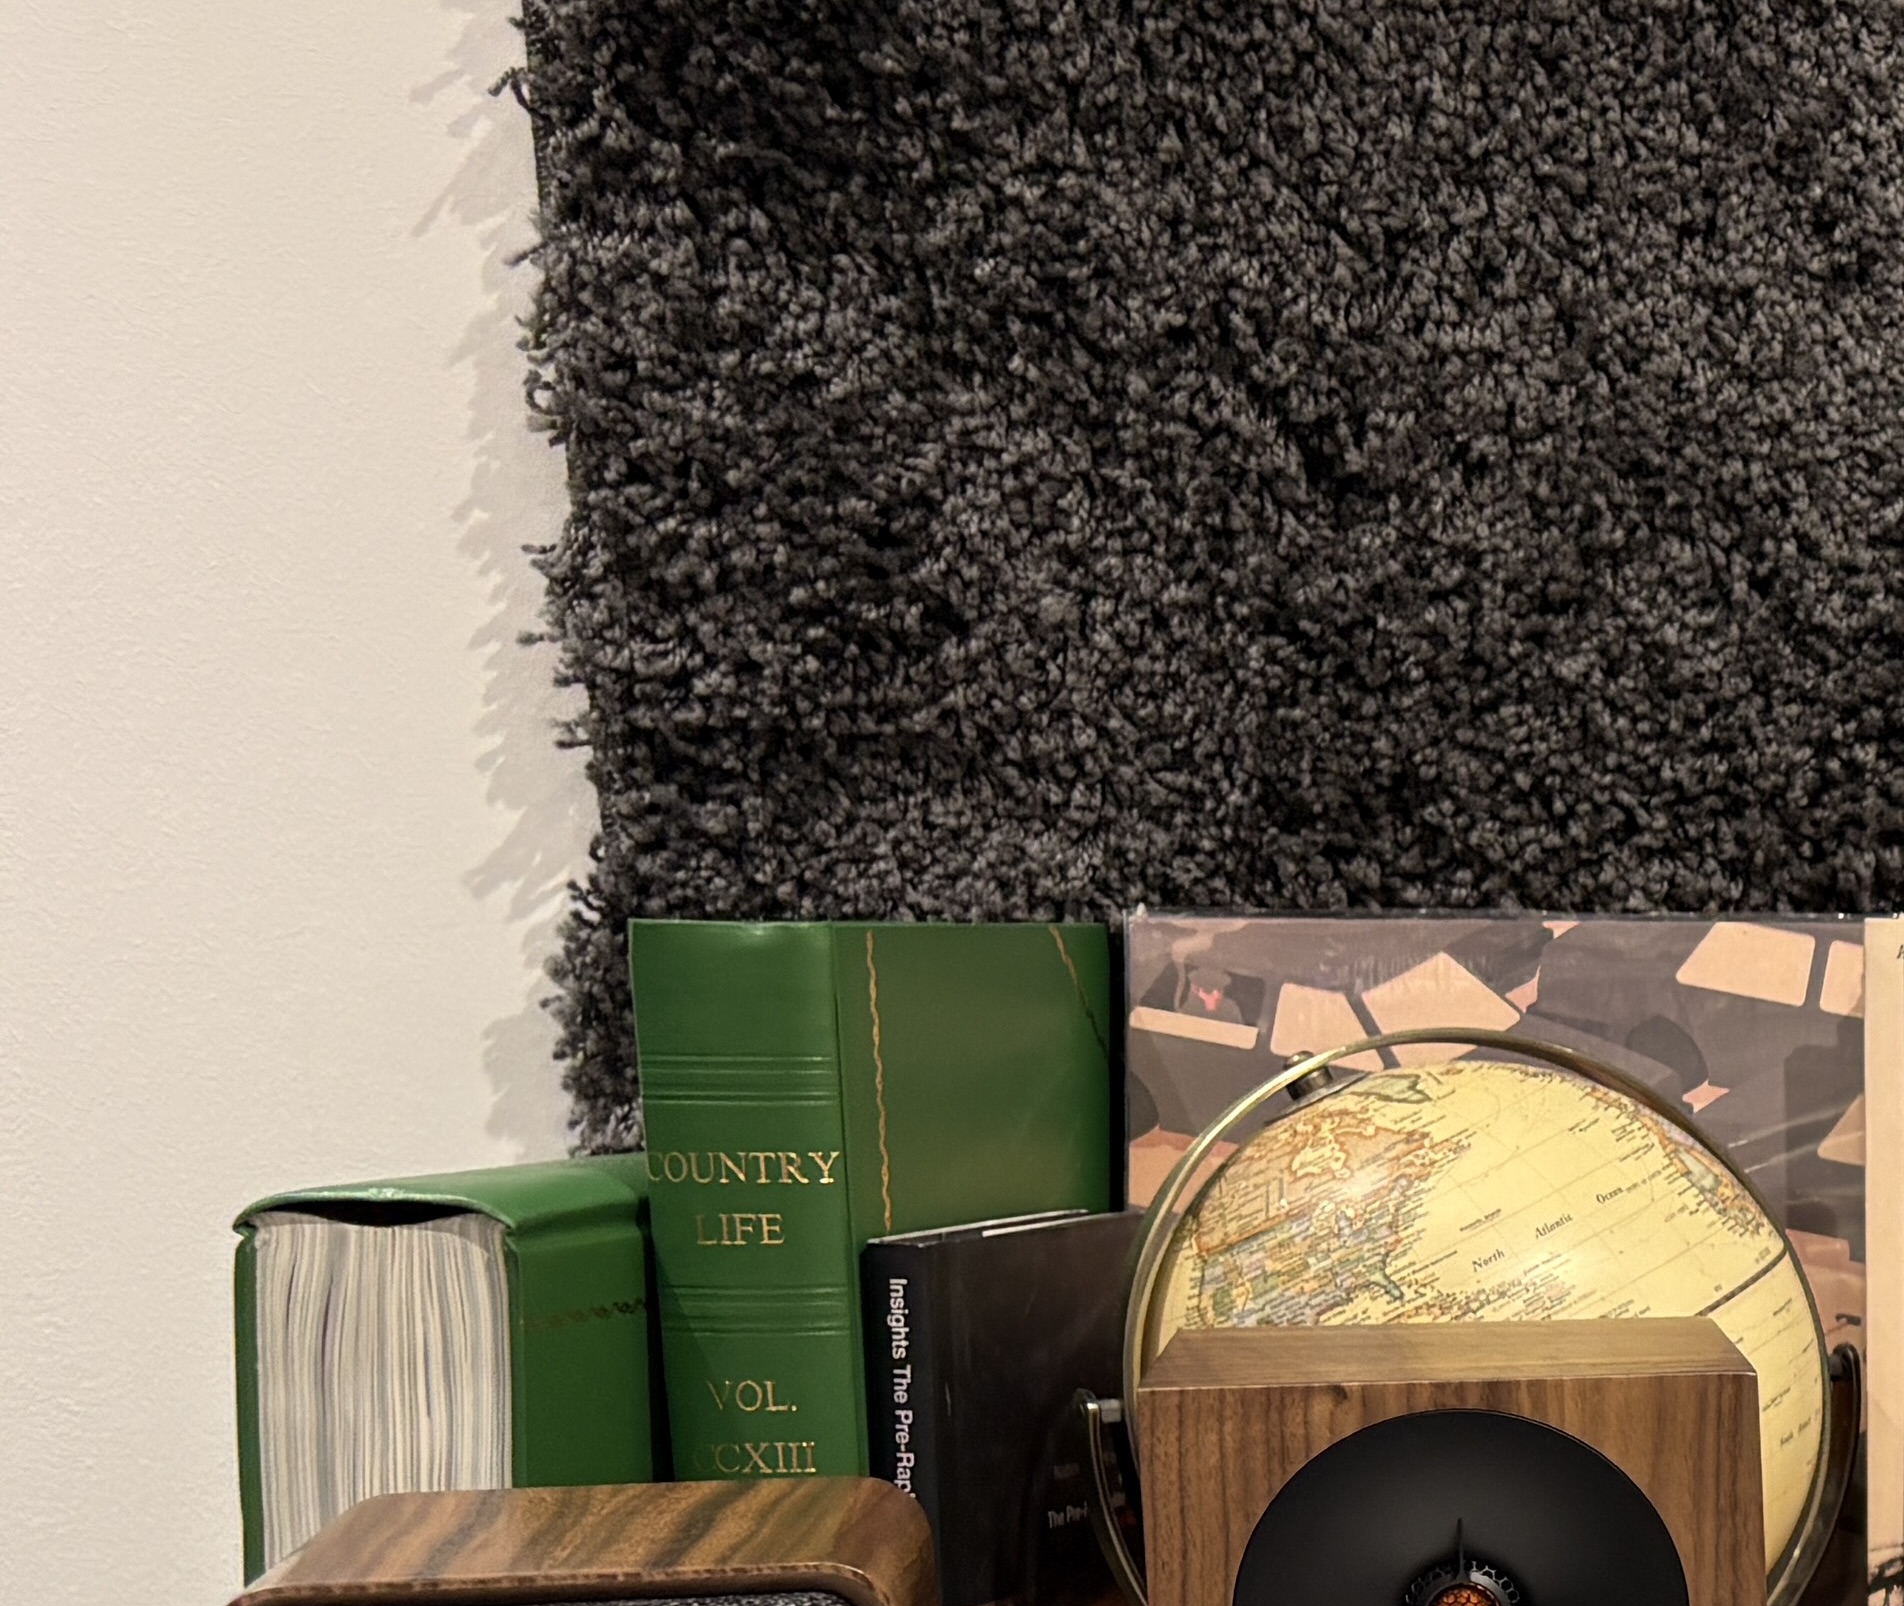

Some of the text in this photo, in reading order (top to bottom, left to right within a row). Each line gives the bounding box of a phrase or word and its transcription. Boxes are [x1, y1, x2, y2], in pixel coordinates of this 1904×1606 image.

[648, 1151, 840, 1184] COUNTRY
[696, 1213, 785, 1245] LIFE
[706, 1379, 797, 1412] VOL.
[887, 1278, 916, 1499] Insights The Pre-Rap
